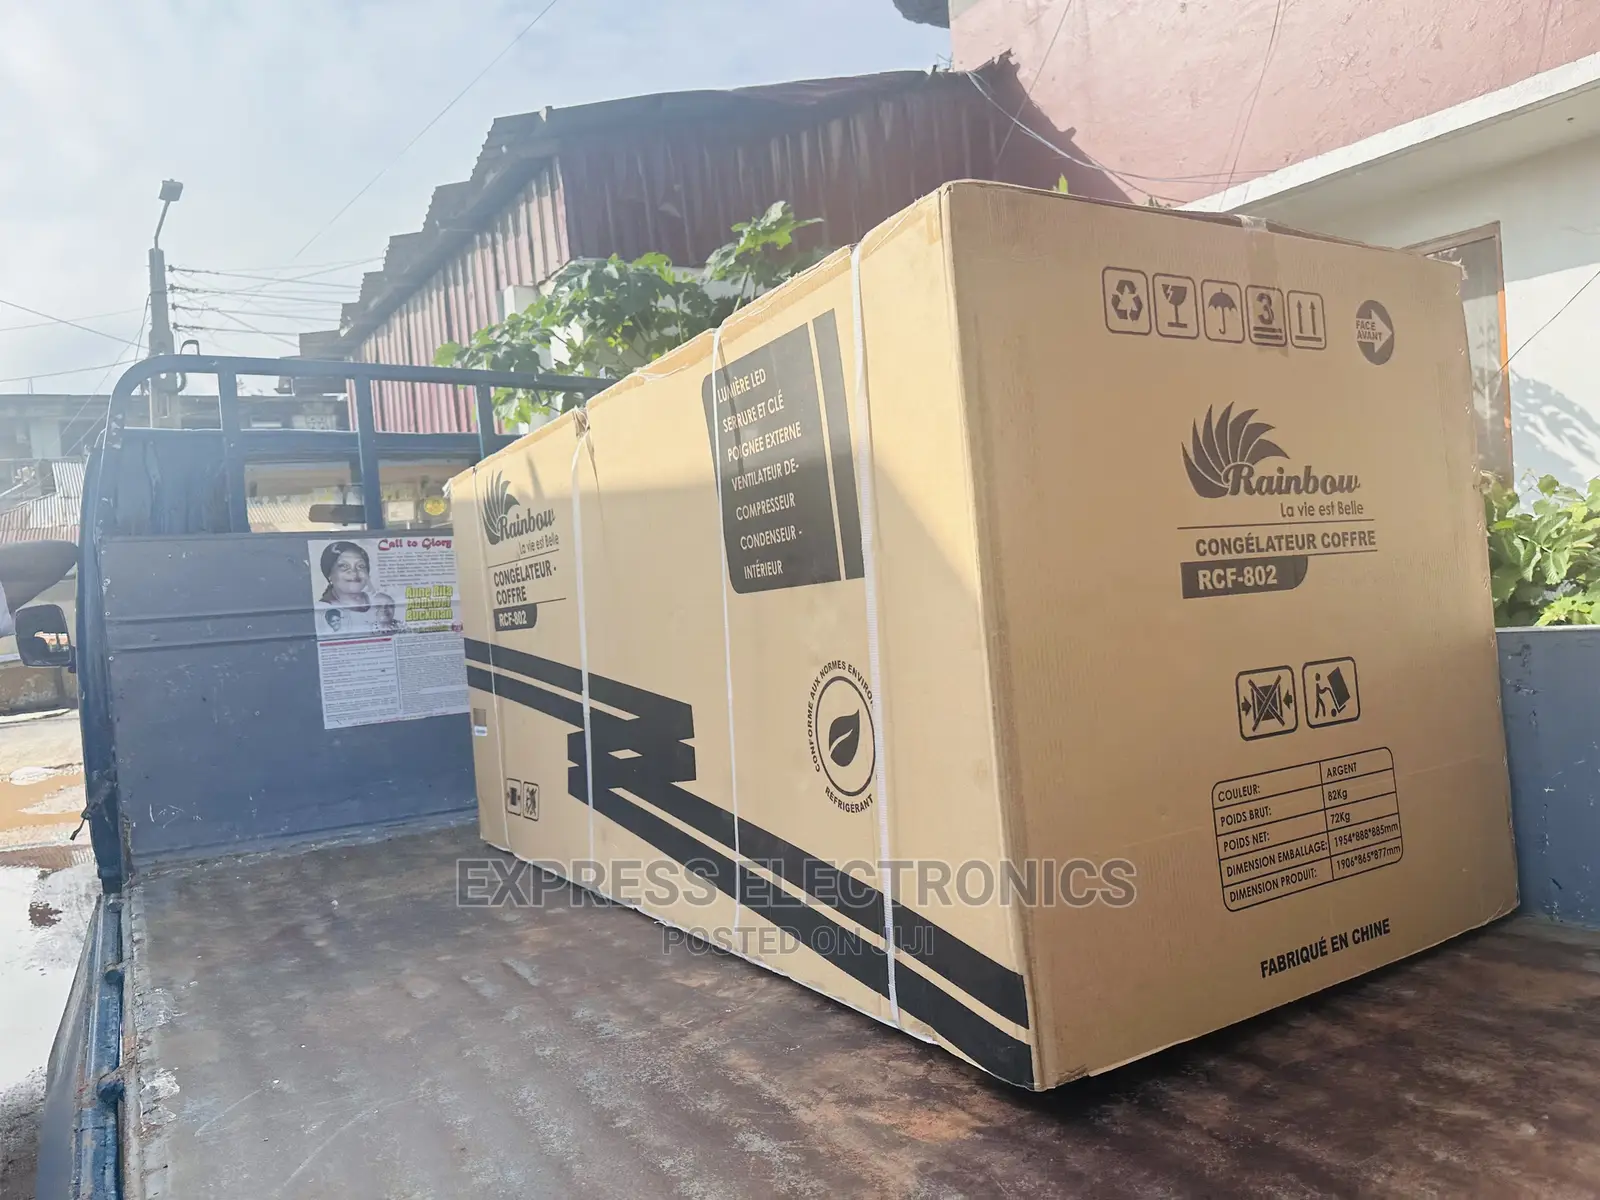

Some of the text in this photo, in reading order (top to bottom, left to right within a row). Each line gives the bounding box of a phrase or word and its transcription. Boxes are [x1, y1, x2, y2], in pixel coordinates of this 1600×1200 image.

[1356, 319, 1376, 331] FACE
[1356, 330, 1383, 342] AVANT
[750, 368, 766, 388] LED
[722, 388, 785, 433] SERRURE ET CLÉ
[764, 421, 802, 449] EXTERNE
[731, 463, 783, 492] VENTILATEUR
[1222, 464, 1361, 496] Rainbow
[735, 492, 796, 521] COMPRESSEUR
[1280, 500, 1364, 518] La vie est Belle
[496, 507, 556, 541] Rainbow
[740, 525, 797, 550] CONDENSEUR
[378, 537, 452, 551] Call to Glory
[1195, 530, 1377, 557] CONGÉLATEUR COFFRE
[493, 559, 553, 587] CONGÉLATEUR
[743, 559, 784, 580] INTÉRIEUR
[1197, 564, 1278, 590] RCF-802
[496, 585, 527, 605] COFFRE
[498, 610, 528, 627] RCF-802
[807, 660, 873, 772] CONFORME AUX NORMES ENVIRO
[1217, 762, 1357, 802] COULEUR: ARGENT
[1220, 788, 1348, 827] POIDS BRUT: 82Kg
[1223, 811, 1350, 852] POIDS NET: 72Kg
[1226, 857, 1275, 877] DIMENSION
[1277, 840, 1328, 863] EMBALLAGE:
[1229, 880, 1279, 903] DIMENSION
[1280, 867, 1317, 887] PRODUIT:
[1260, 917, 1391, 979] FABRIQUÉ EN CHINE
